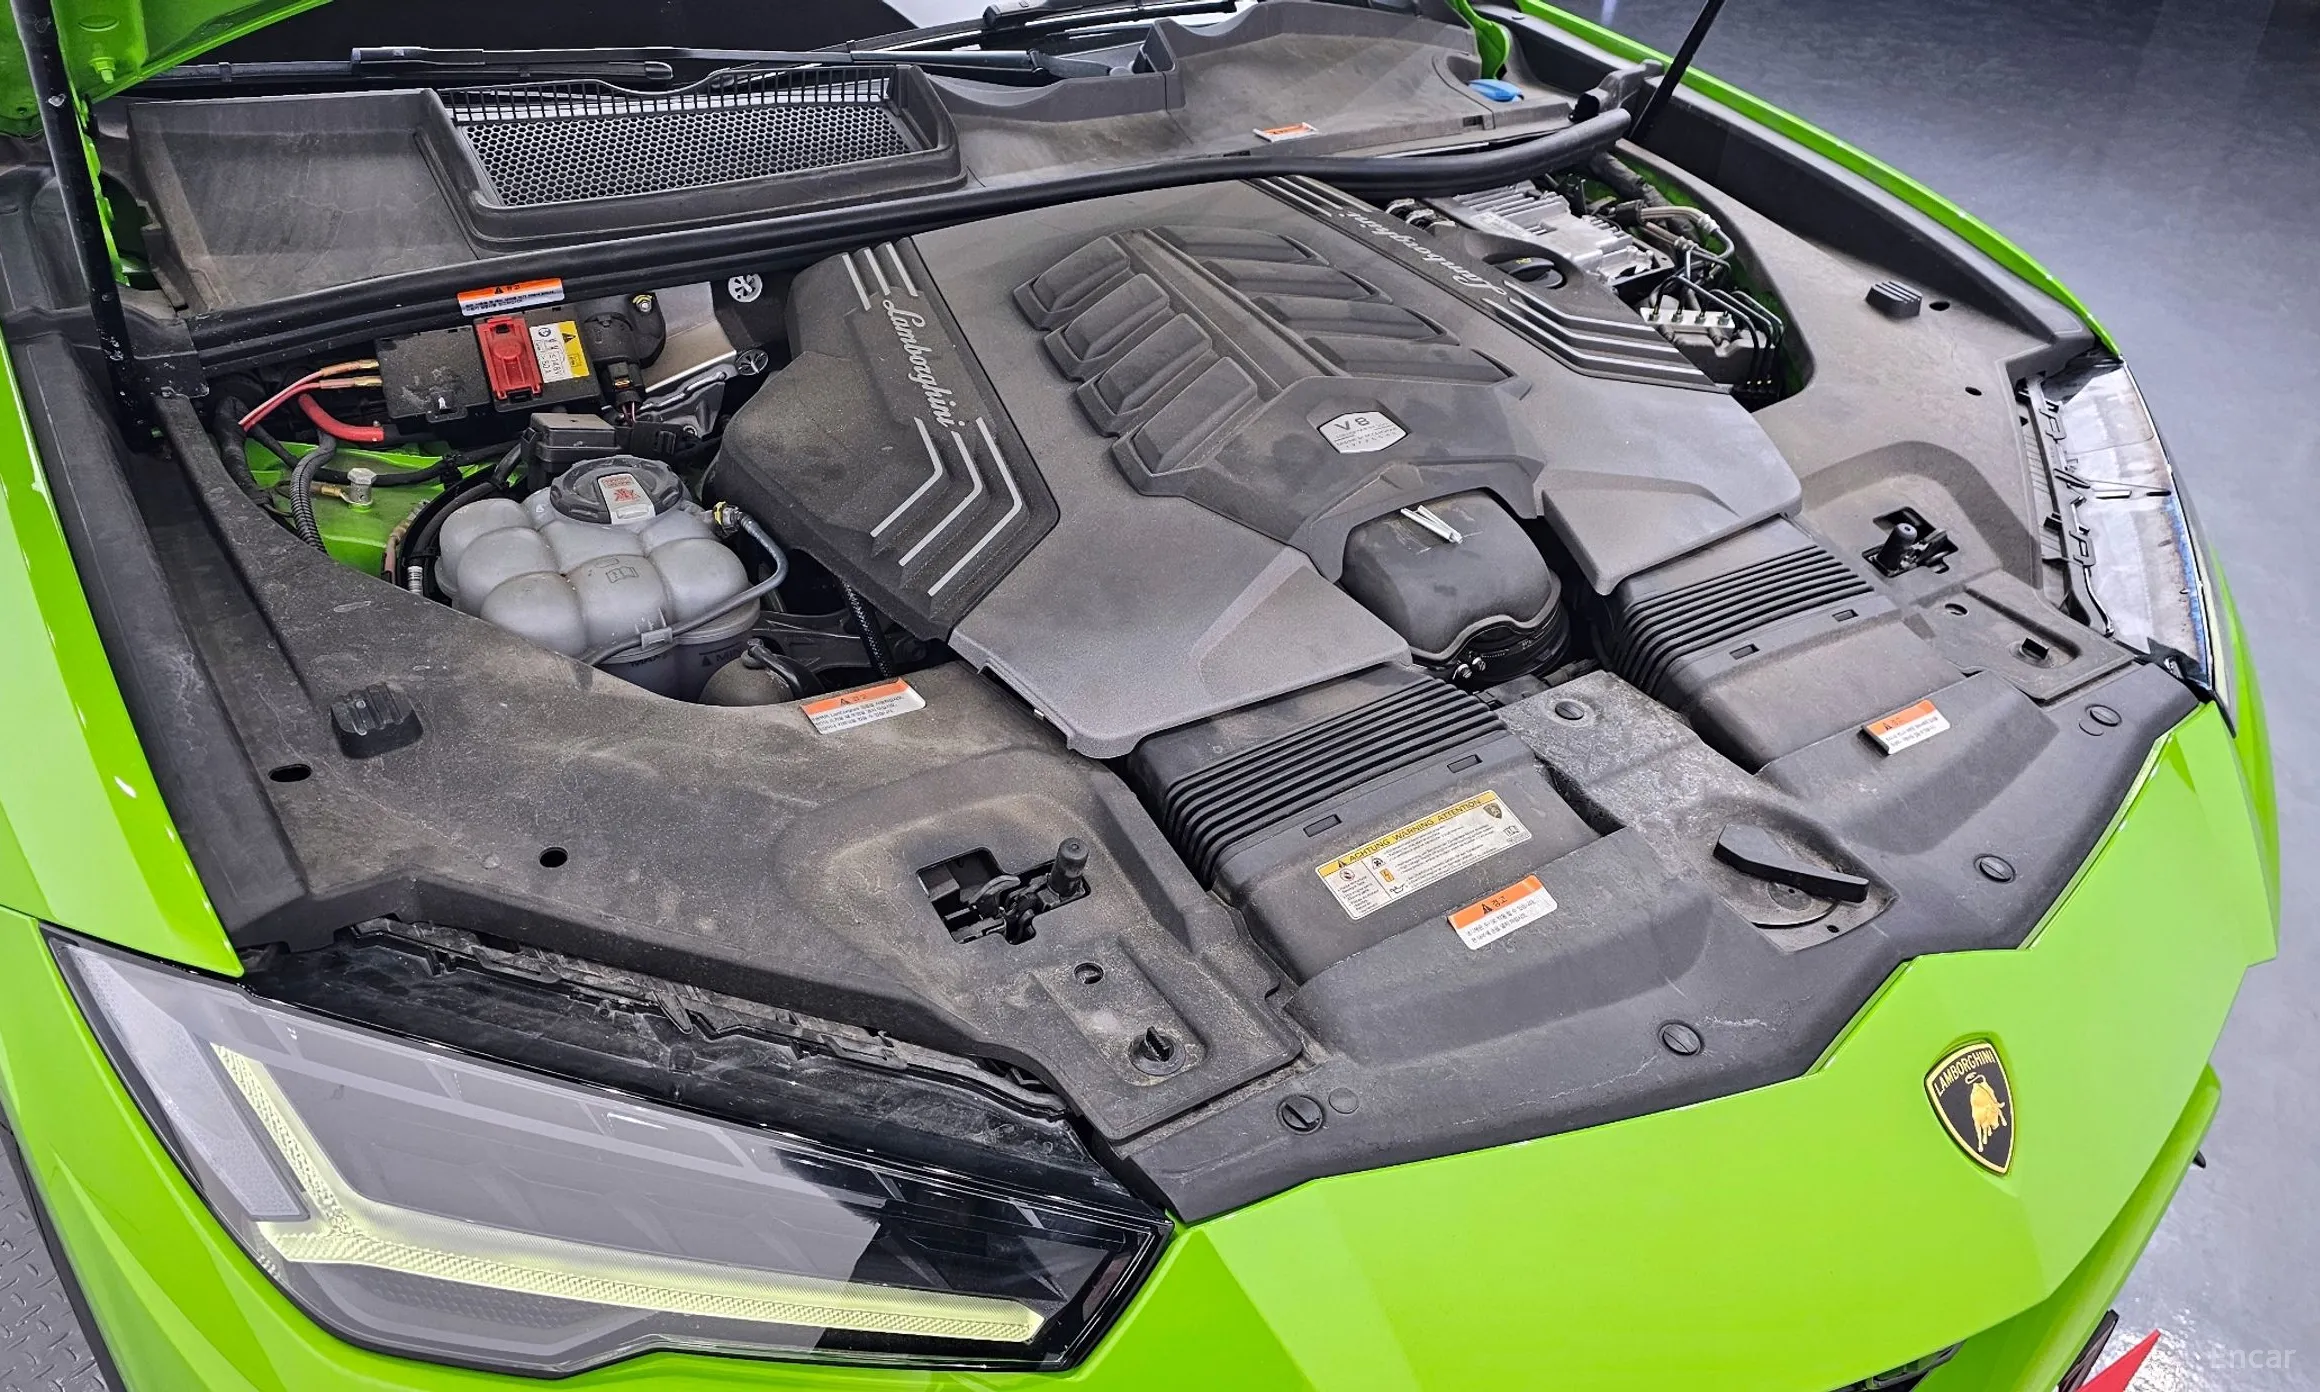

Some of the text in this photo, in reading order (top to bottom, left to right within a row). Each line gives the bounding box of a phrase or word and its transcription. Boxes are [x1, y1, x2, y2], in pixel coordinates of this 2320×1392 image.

[1339, 211, 1507, 296] Lamborghini
[882, 299, 965, 428] Lamborghini
[1349, 798, 1482, 862] ACHTUNG WARNING ATTENTION
[1933, 1050, 1996, 1098] LAMBORGHINI
